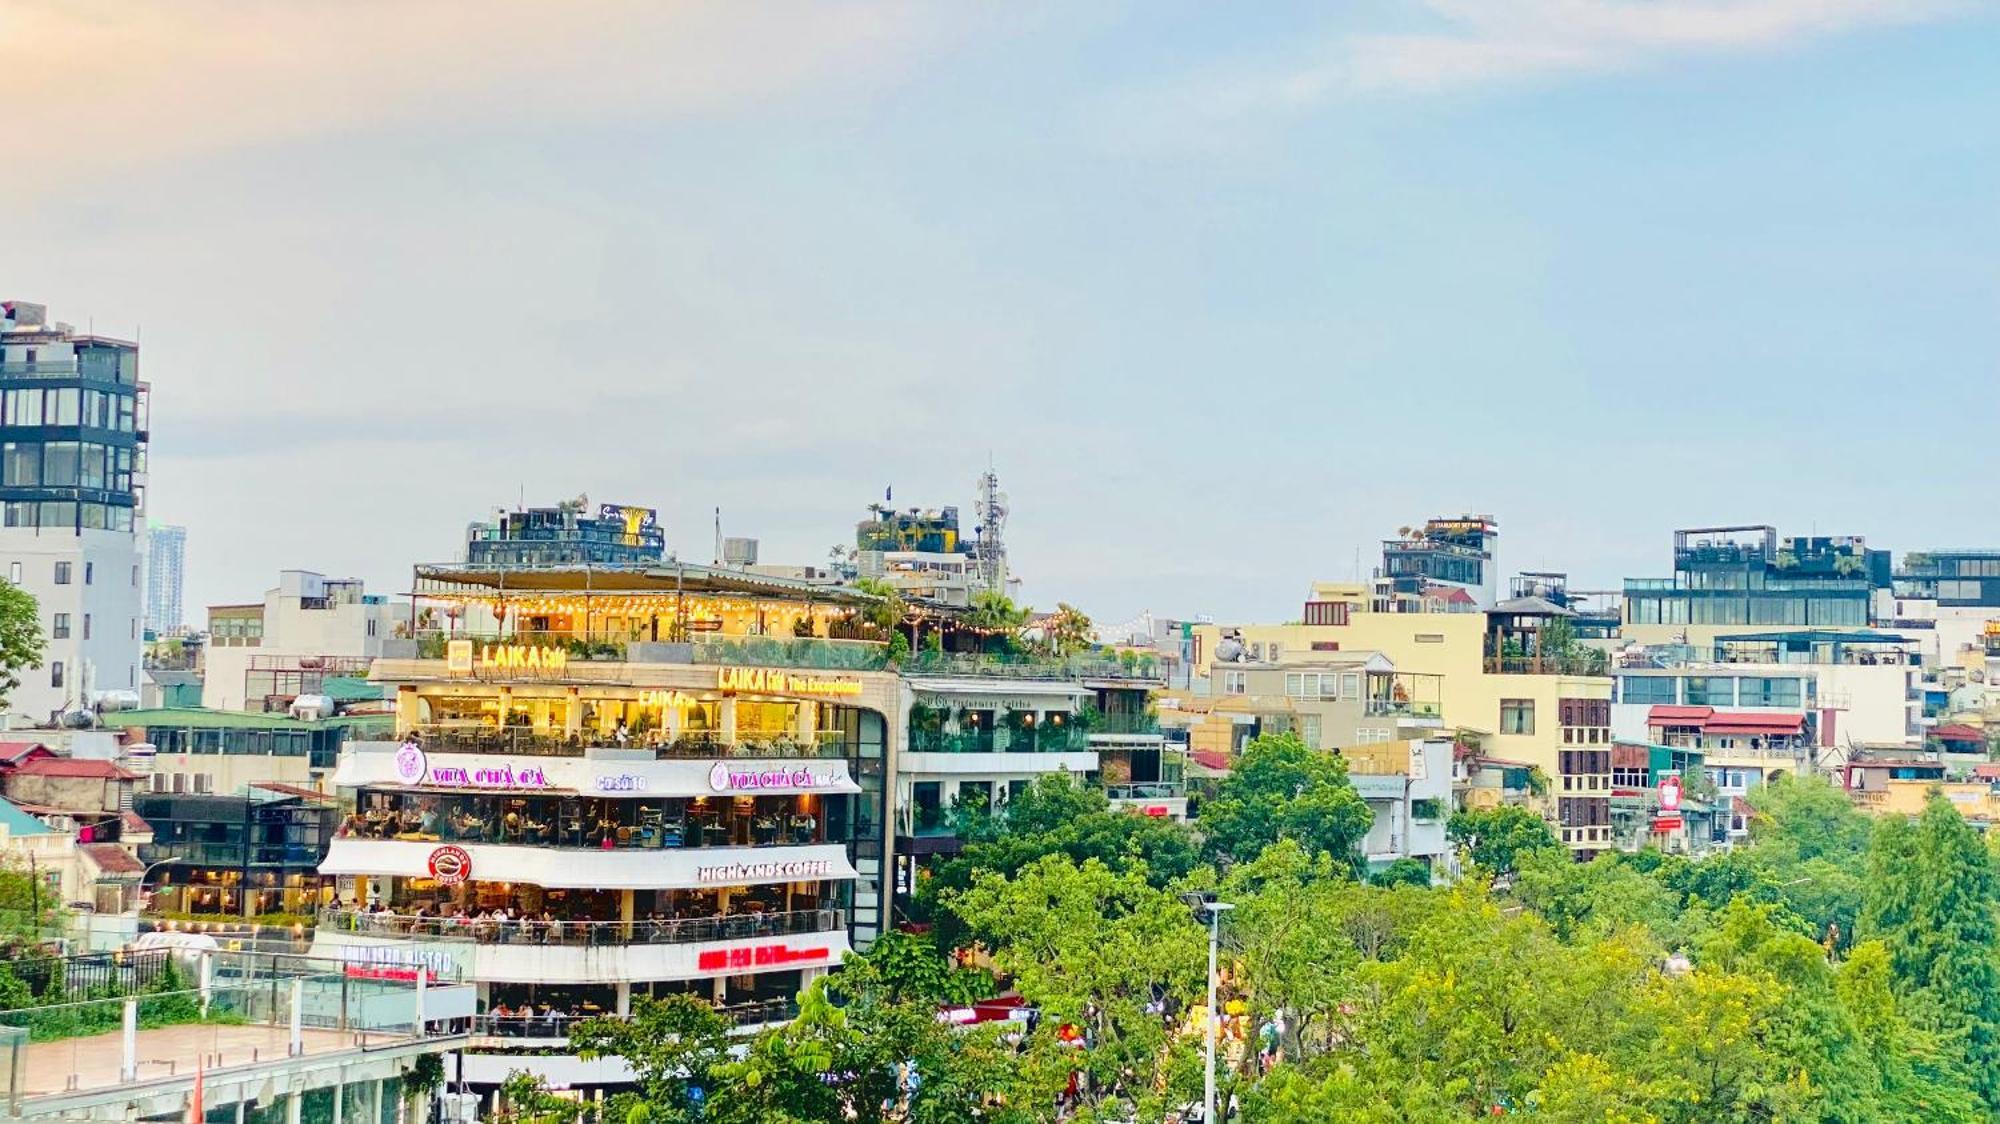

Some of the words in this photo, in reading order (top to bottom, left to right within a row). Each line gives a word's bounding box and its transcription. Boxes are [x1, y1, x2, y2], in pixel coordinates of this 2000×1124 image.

[482, 644, 541, 668] LAIKA
[718, 666, 766, 690] LAIKA
[788, 675, 807, 692] The
[807, 677, 863, 695] Exceptional
[700, 862, 782, 881] HIGHLANDS
[784, 861, 832, 875] COFFEE
